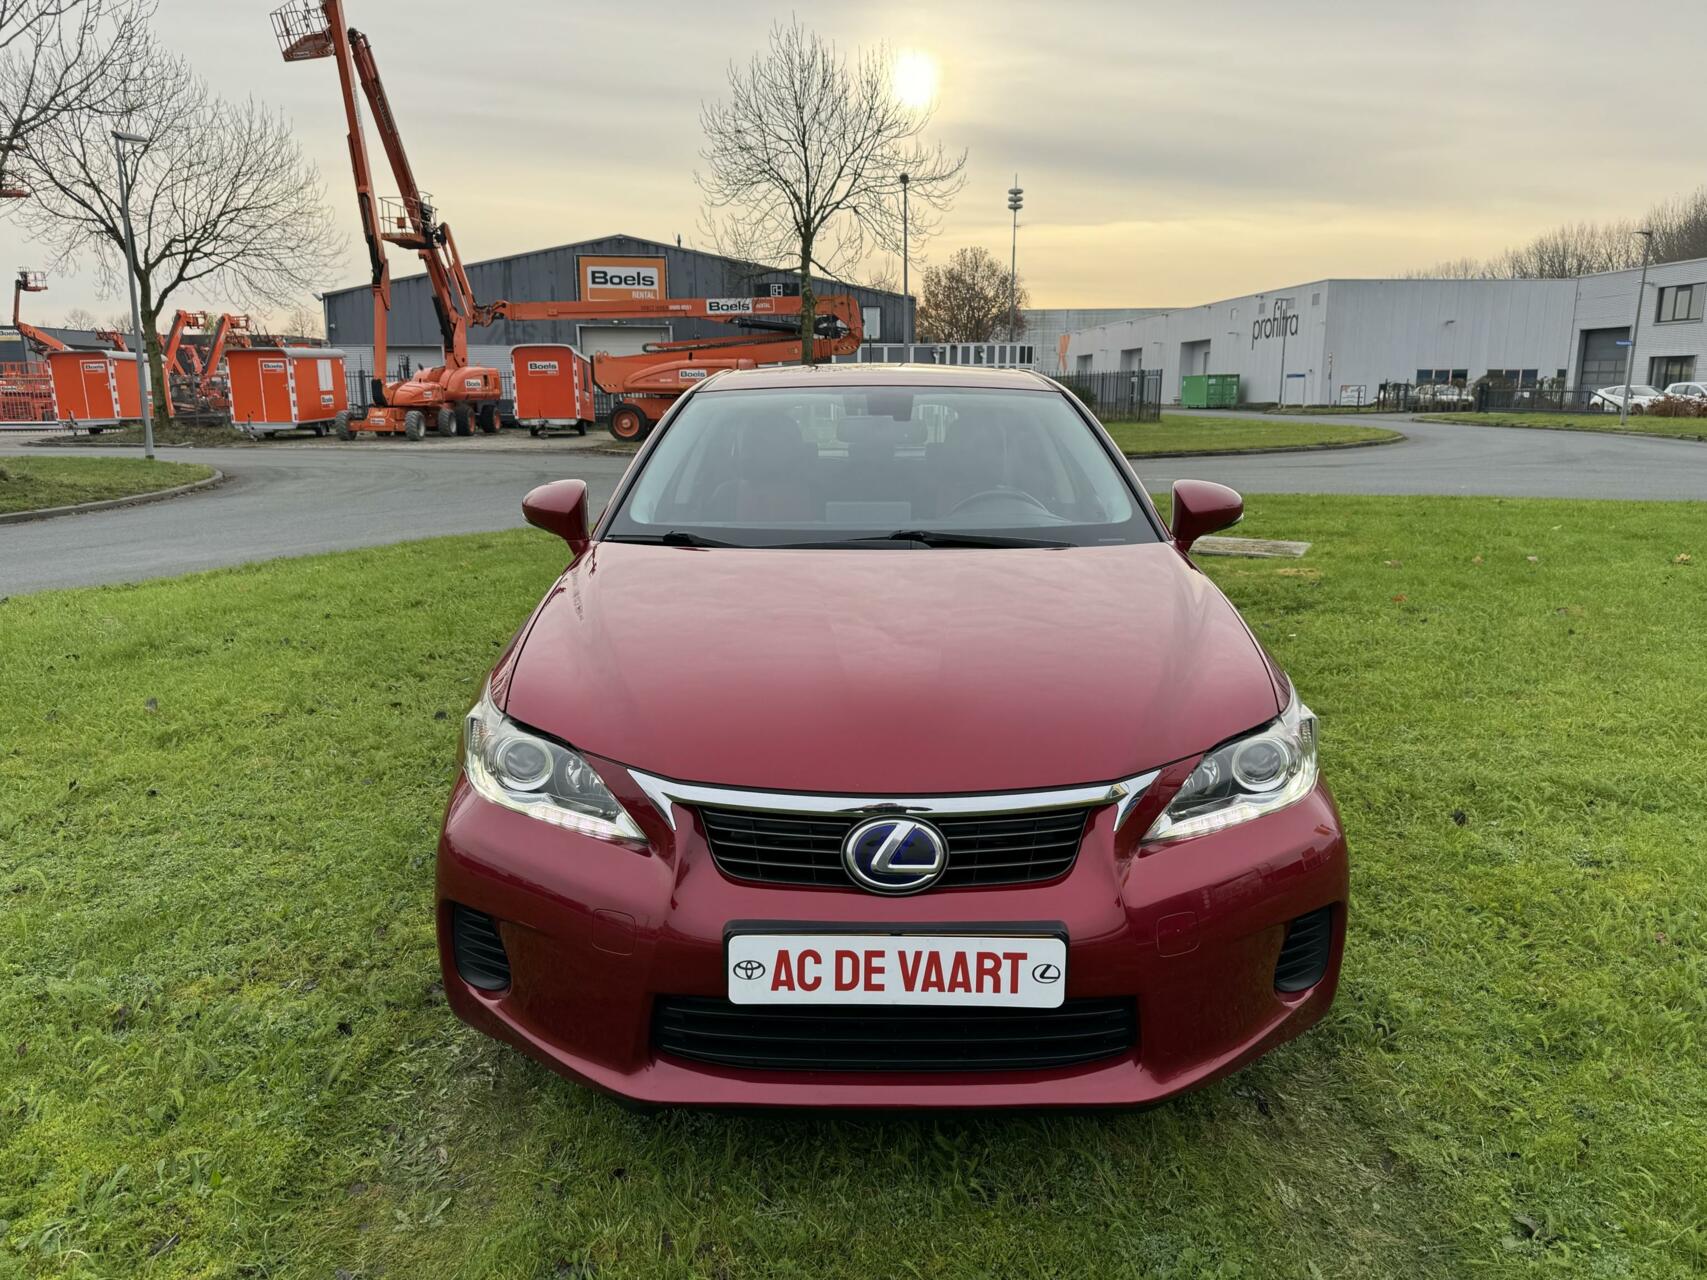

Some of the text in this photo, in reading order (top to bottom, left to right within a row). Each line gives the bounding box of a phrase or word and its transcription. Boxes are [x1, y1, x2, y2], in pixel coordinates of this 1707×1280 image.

[591, 270, 655, 287] Boels
[632, 290, 655, 299] RENTAL
[709, 301, 750, 311] Boels
[1251, 300, 1299, 351] profiltra
[529, 362, 557, 370] Boels
[680, 370, 706, 378] Boels
[770, 949, 822, 992] AC
[834, 949, 885, 992] DE
[897, 950, 1028, 994] VAART
